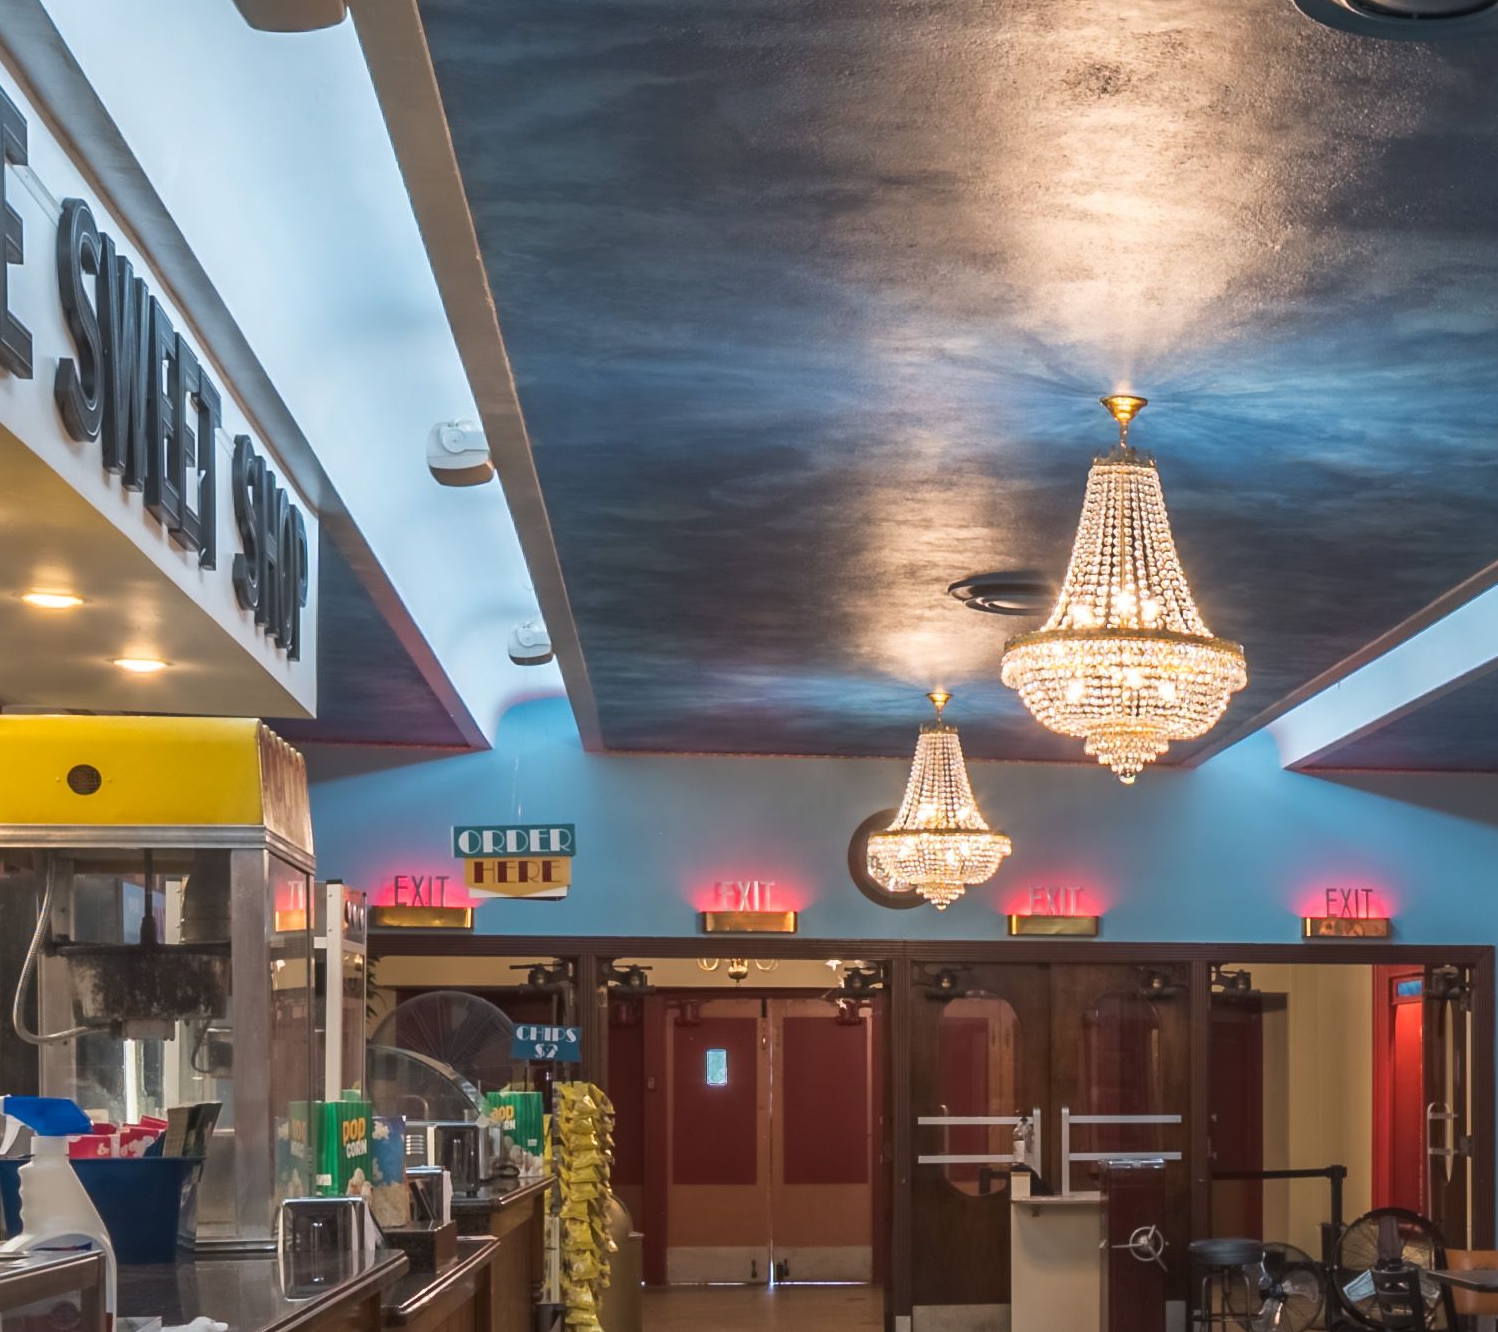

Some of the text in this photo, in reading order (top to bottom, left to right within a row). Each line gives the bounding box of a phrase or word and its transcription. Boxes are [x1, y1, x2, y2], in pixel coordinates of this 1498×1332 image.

[53, 197, 222, 571] SWEET
[233, 434, 309, 662] SHOP
[458, 828, 573, 854] ORDER
[473, 859, 563, 884] HERE
[394, 875, 450, 908] EXIT
[720, 880, 776, 912] EXIT
[1029, 885, 1082, 917] EXIT
[1325, 888, 1374, 919] EXIT
[516, 1026, 577, 1043] CHIPS
[535, 1043, 559, 1058] $2
[346, 1138, 368, 1159] CORN
